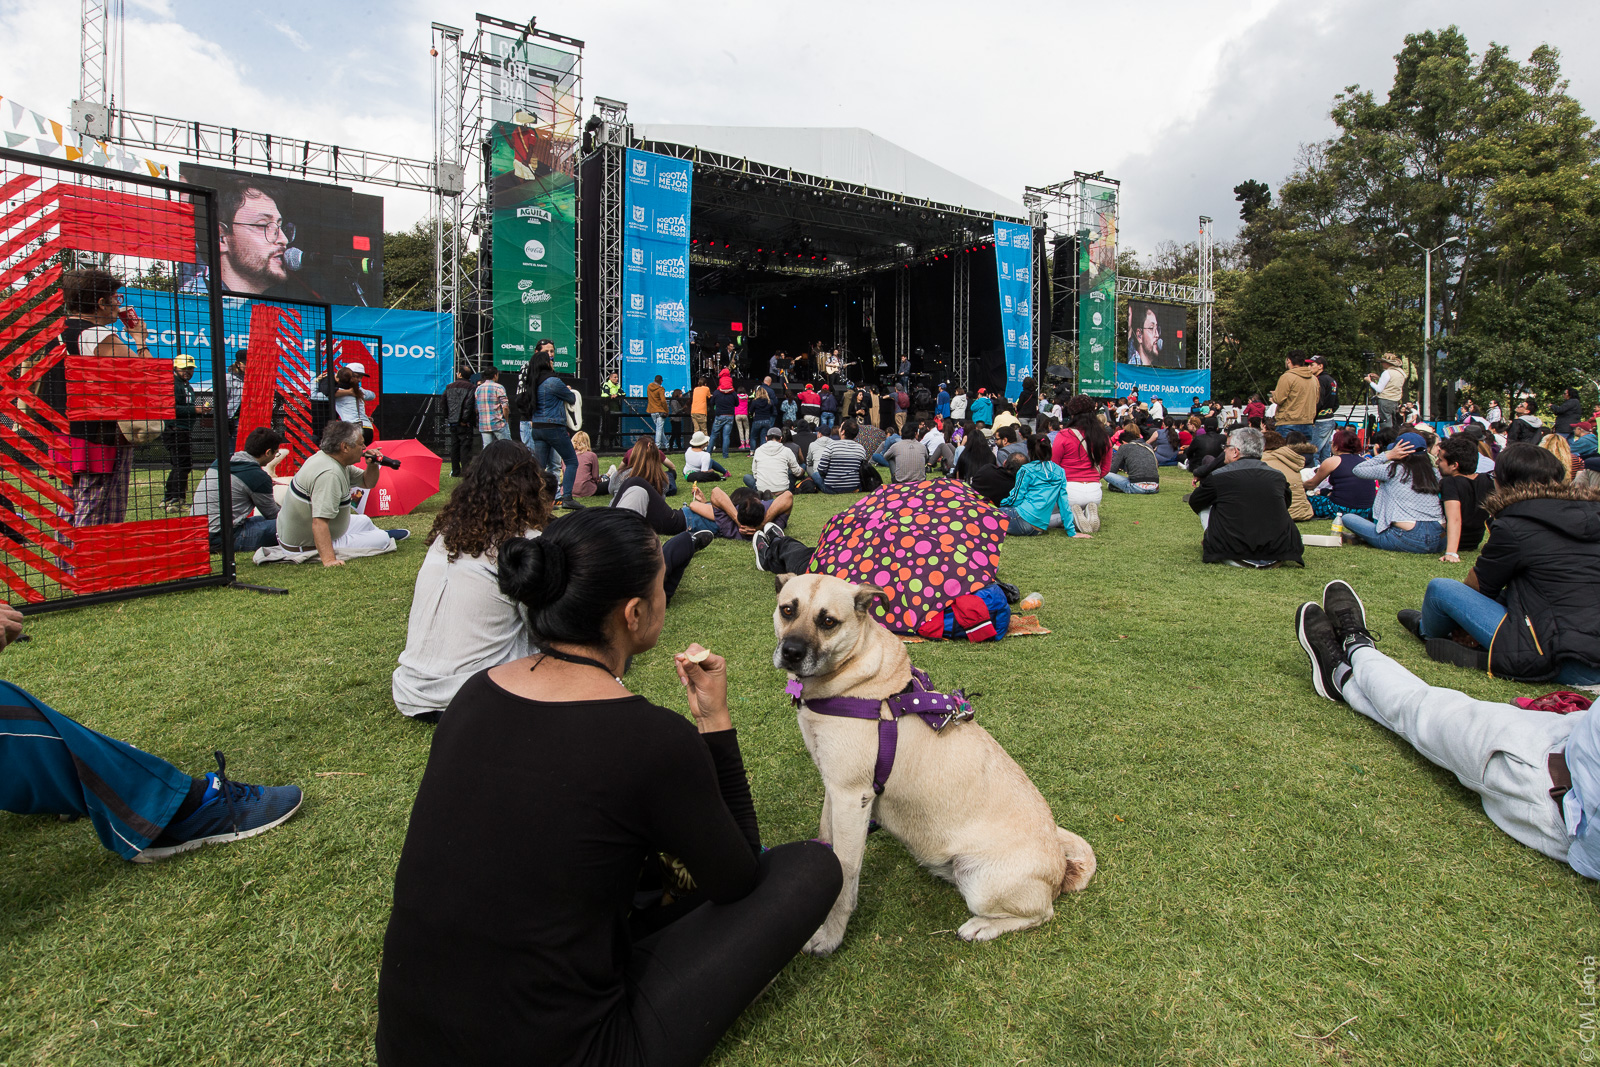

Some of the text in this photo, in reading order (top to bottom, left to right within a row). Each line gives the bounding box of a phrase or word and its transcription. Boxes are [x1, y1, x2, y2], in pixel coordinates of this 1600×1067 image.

[659, 170, 688, 181] BOGOTÁ
[659, 177, 688, 188] MEJOR
[520, 208, 548, 219] AGUILA
[656, 214, 686, 226] BOGOTÁ
[656, 222, 686, 232] MEJOR
[656, 256, 685, 267] BOGOTÁ
[656, 264, 685, 274] MEJOR
[656, 300, 684, 311] BOGOTÁ
[656, 309, 685, 318] MEJOR
[366, 342, 436, 359] TODOS
[656, 342, 686, 354] BOGOTÁ
[656, 353, 686, 361] MEJOR
[1138, 384, 1160, 392] MEJOR
[1161, 385, 1180, 394] PARA
[1180, 386, 1204, 394] TODOS
